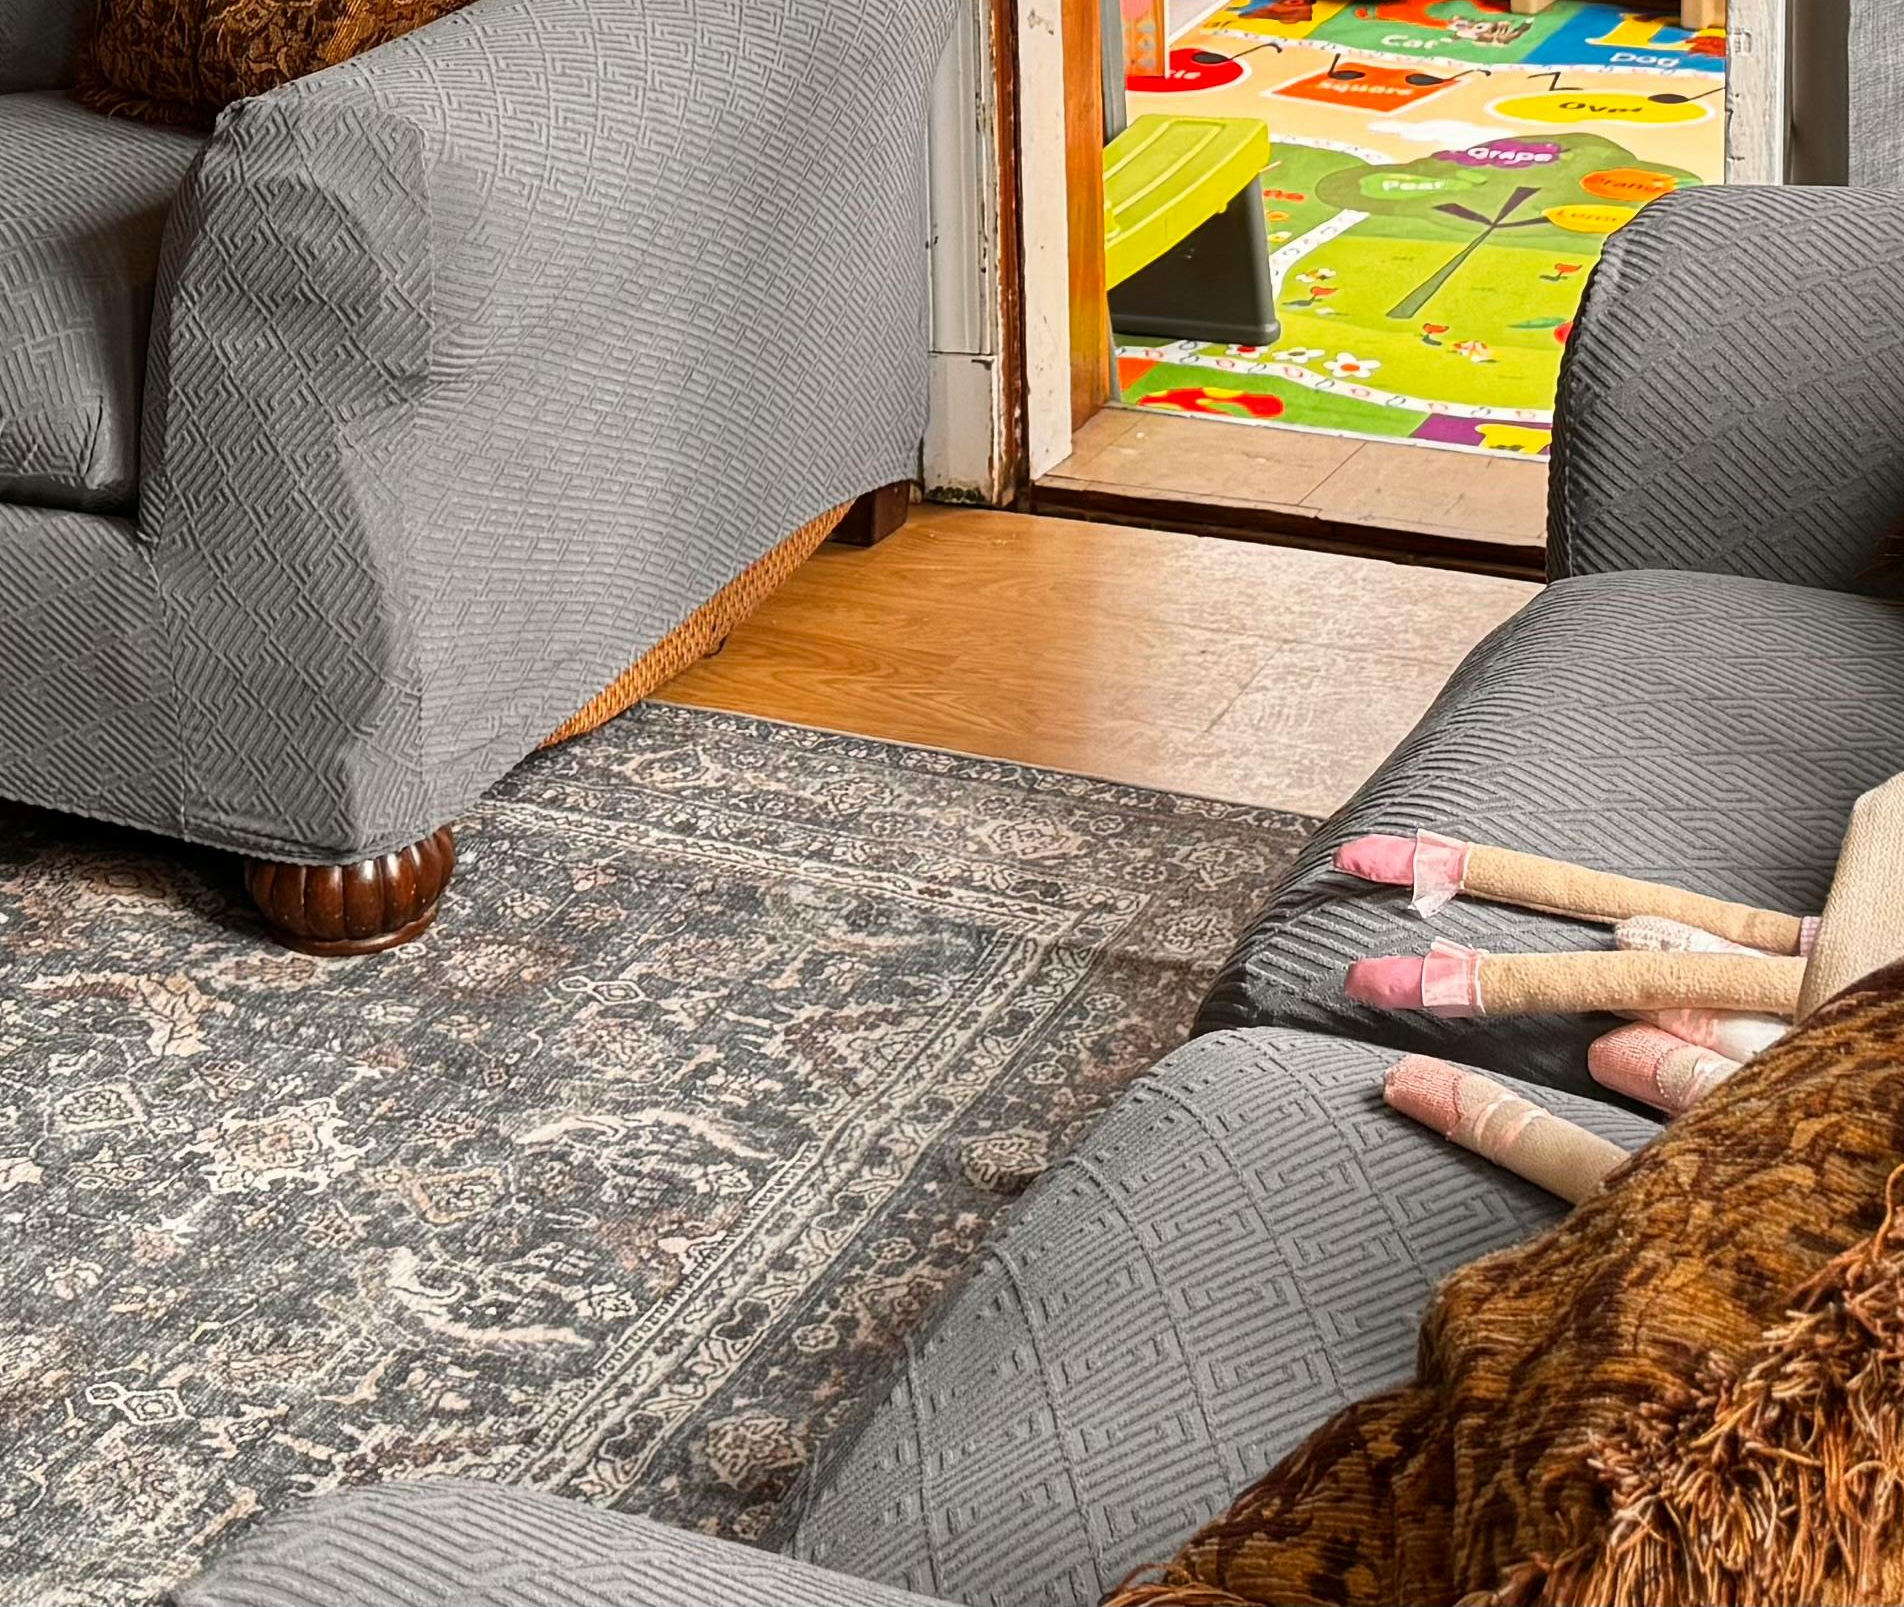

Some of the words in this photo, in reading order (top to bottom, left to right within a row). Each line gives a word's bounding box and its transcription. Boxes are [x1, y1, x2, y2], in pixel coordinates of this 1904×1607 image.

[1610, 51, 1681, 68] Dog
[1467, 147, 1553, 165] Grape
[1382, 180, 1445, 192] Pear
